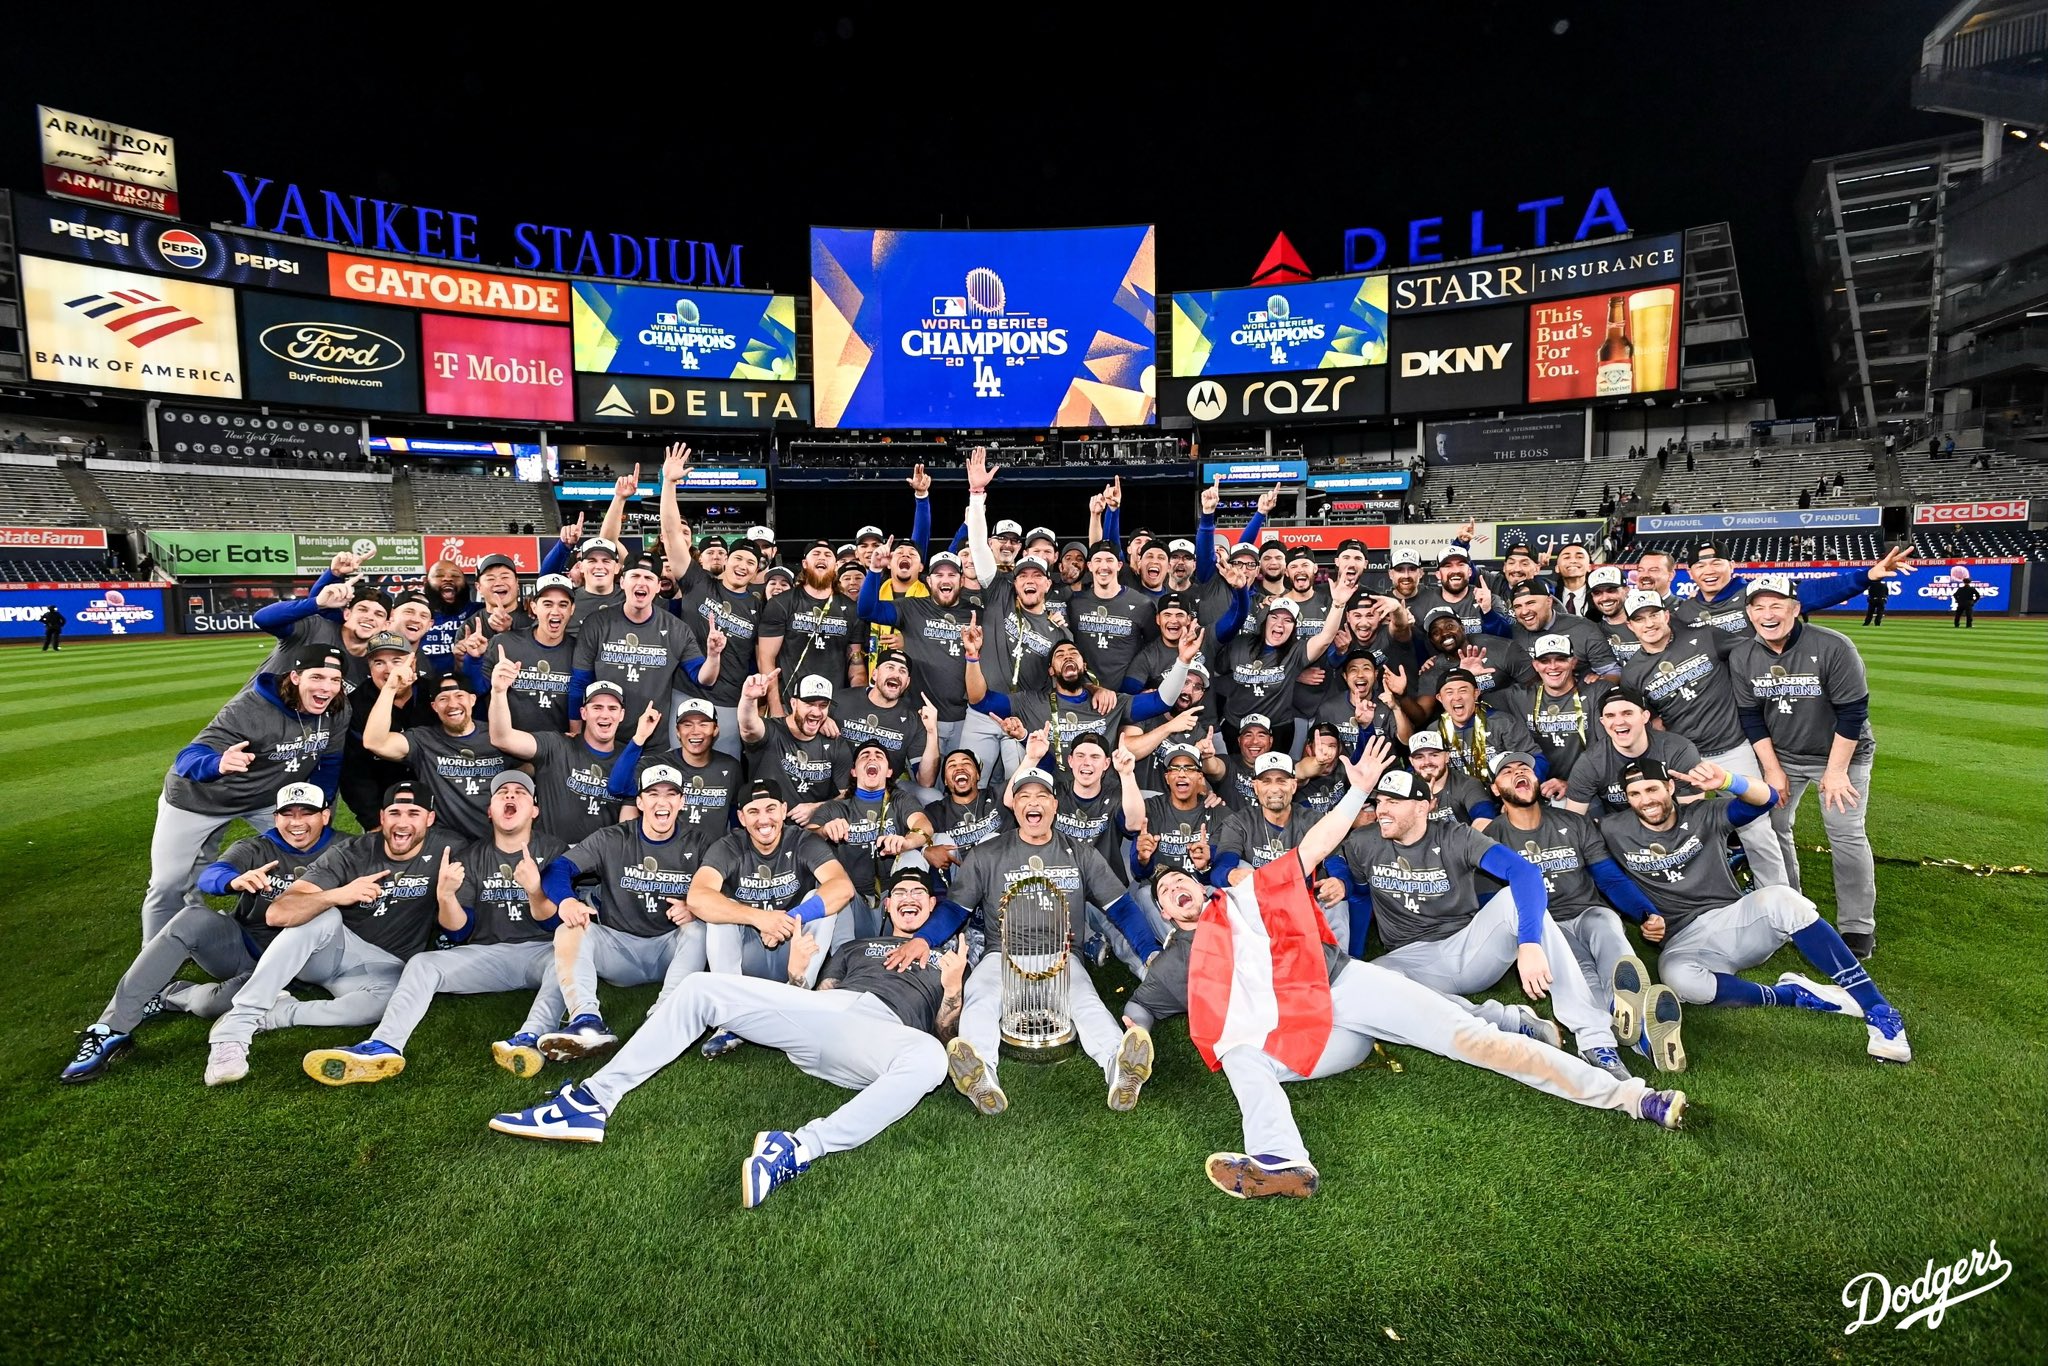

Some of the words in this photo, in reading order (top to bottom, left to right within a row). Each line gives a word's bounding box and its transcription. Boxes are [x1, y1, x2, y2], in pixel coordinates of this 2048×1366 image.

[46, 118, 168, 156] ARMITRON
[58, 171, 166, 203] ARMITRON
[113, 194, 165, 211] WATCHES
[50, 218, 129, 247] PEPSI
[223, 170, 480, 263] YANKEE
[514, 222, 745, 288] STADIUM
[1344, 186, 1629, 273] DELTA
[162, 242, 204, 258] PEPSI
[234, 252, 299, 275] PEPSI
[1396, 264, 1528, 309] STARR
[1540, 249, 1674, 283] INSURANCE
[345, 263, 559, 314] GATORADE
[921, 318, 982, 330] WORLD
[986, 317, 1047, 330] SERIES
[1536, 306, 1583, 325] This
[651, 324, 687, 333] WORLD
[688, 327, 724, 335] SERIES
[1242, 322, 1277, 330] WORLD
[1278, 318, 1314, 328] SERIES
[638, 329, 736, 350] CHAMPIONS
[1230, 324, 1325, 345] CHAMPIONS
[1537, 323, 1593, 344] Bud's
[287, 327, 379, 368] Ford
[901, 329, 1067, 356] CHAMPIONS
[681, 346, 699, 369] LA
[1270, 341, 1287, 364] LA
[1401, 343, 1514, 378] DKNY
[1537, 345, 1571, 361] For
[36, 351, 99, 370] BANK
[107, 359, 134, 373] OF
[141, 364, 235, 384] AMERICA
[945, 357, 964, 367] 20
[1005, 356, 1025, 367] 24
[467, 355, 564, 387] Mobile
[973, 356, 1001, 398] LA
[1535, 362, 1580, 378] You.
[288, 371, 383, 388] BuyFordNow.com
[649, 388, 798, 419] DELTA
[1243, 375, 1356, 416] razr
[222, 429, 245, 440] New
[244, 431, 267, 444] York
[267, 433, 305, 446] Yankees
[1494, 451, 1515, 460] THE
[1520, 448, 1549, 458] BOSS
[1262, 471, 1297, 479] DODGERS
[1364, 501, 1399, 509] TERRACE
[1737, 517, 1778, 525] FANDUEL
[1815, 513, 1861, 522] FANDUEL
[1916, 504, 2025, 523] Reebok
[1663, 519, 1703, 527] FANDUEL
[299, 536, 350, 548] Morningside
[1282, 534, 1322, 543] TOYOTA
[227, 544, 290, 563] Eats
[396, 546, 418, 555] Circle
[76, 610, 154, 622] CHAMPIONS
[728, 614, 754, 631] SERIES
[820, 617, 847, 627] SERIES
[1079, 614, 1106, 624] WORLD
[1106, 616, 1132, 627] SERIES
[1712, 611, 1744, 626] SERIES
[926, 619, 956, 630] WORLD
[1078, 621, 1132, 636] CHAMPIONS
[426, 634, 438, 642] 20
[1097, 633, 1109, 648] LA
[602, 643, 636, 653] WORLD
[636, 645, 667, 656] SERIES
[601, 651, 667, 666] CHAMPIONS
[626, 664, 639, 682] LA
[1259, 663, 1285, 677] SERIES
[1646, 670, 1676, 692] WORLD
[1675, 654, 1709, 676] SERIES
[1650, 661, 1713, 700] CHAMPIONS
[1751, 678, 1786, 688] WORLD
[1785, 676, 1819, 686] SERIES
[1753, 685, 1822, 697] CHAMPIONS
[538, 691, 552, 708] LA
[1777, 698, 1792, 714] LA
[843, 719, 874, 734] WORLD
[875, 728, 904, 741] SERIES
[1077, 718, 1106, 731] SERIES
[437, 756, 475, 767] WORLD
[476, 757, 504, 767] SERIES
[807, 761, 831, 772] SERIES
[465, 777, 480, 795] LA
[701, 788, 728, 797] SERIES
[587, 796, 600, 815] LA
[689, 806, 701, 823] LA
[1057, 813, 1086, 828] WORLD
[848, 823, 876, 833] WORLD
[947, 824, 973, 837] WORLD
[1160, 833, 1190, 844] WORLD
[1542, 847, 1576, 862] SERIES
[624, 867, 655, 880] WORLD
[655, 871, 692, 883] SERIES
[771, 871, 797, 885] SERIES
[1044, 868, 1079, 878] SERIES
[1373, 865, 1407, 880] WORLD
[1406, 868, 1447, 881] SERIES
[620, 876, 690, 894] CHAMPIONS
[735, 881, 800, 900] CHAMPIONS
[1371, 875, 1450, 894] CHAMPIONS
[507, 901, 523, 921] LA
[645, 893, 657, 913] LA
[1404, 894, 1420, 914] LA
